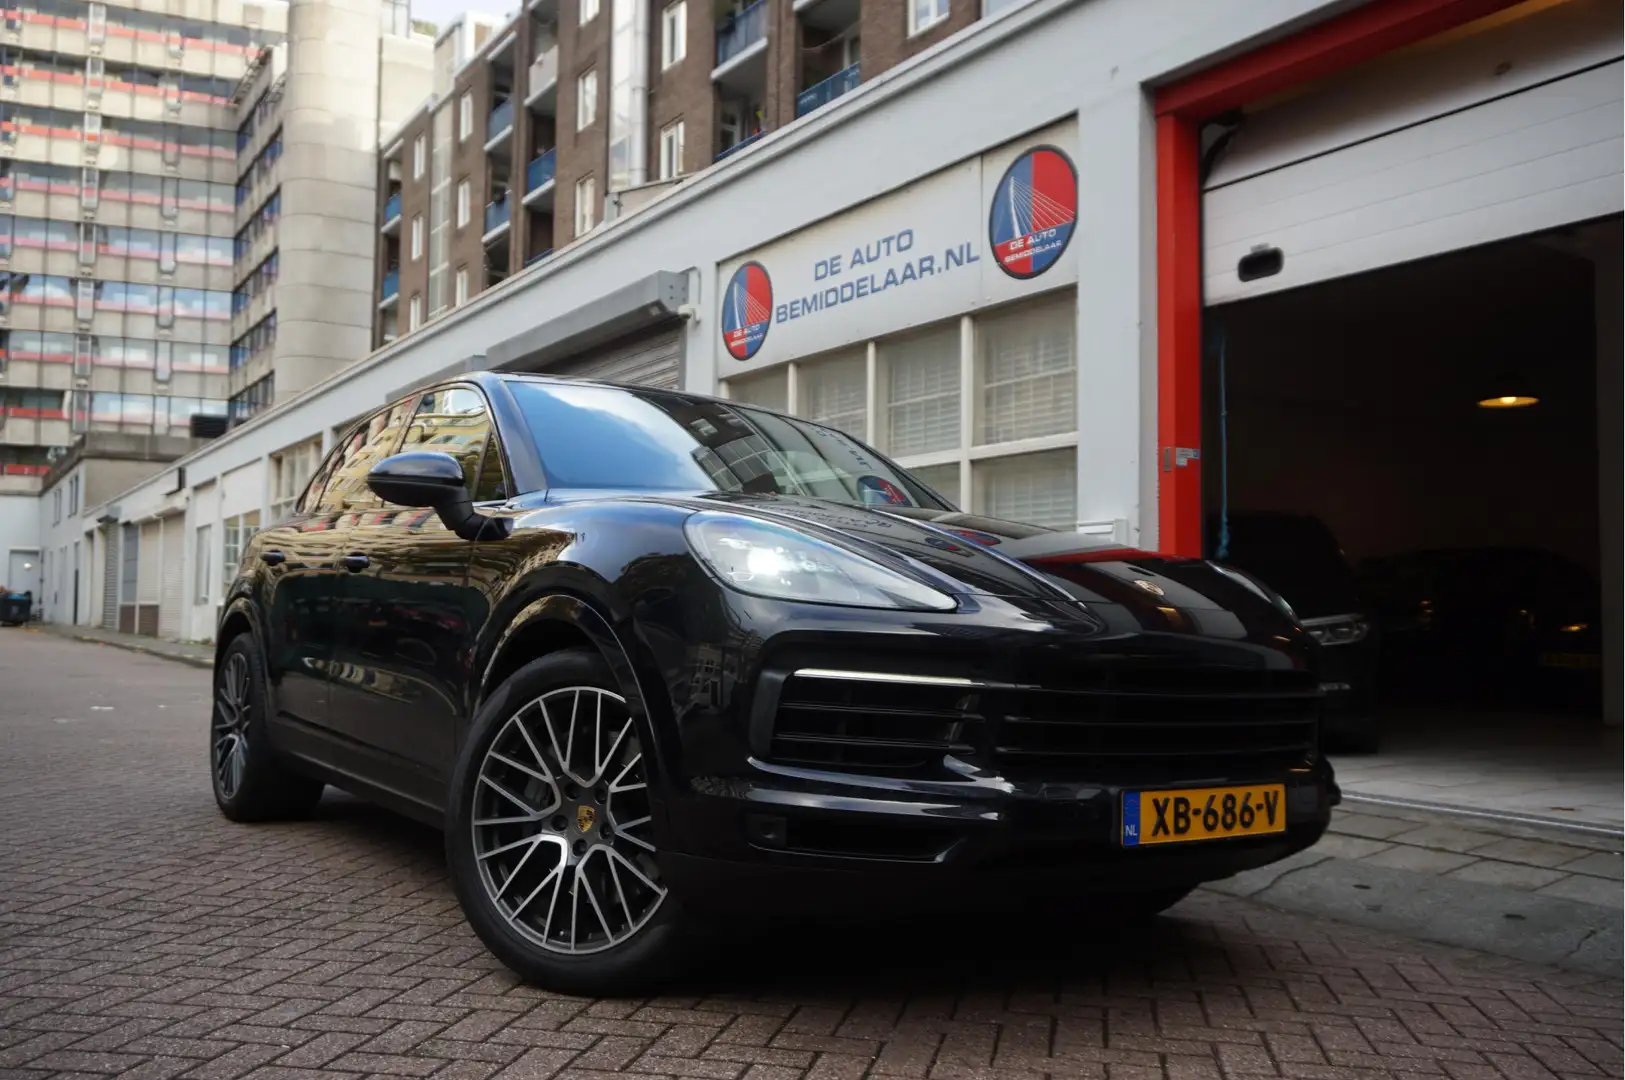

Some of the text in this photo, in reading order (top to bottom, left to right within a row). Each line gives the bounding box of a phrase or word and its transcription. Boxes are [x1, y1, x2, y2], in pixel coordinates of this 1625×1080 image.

[814, 229, 913, 281] DE AUTO
[1009, 229, 1057, 250] DE AUTO
[776, 242, 980, 324] BEMIDDELAAR.NL
[1125, 790, 1280, 837] NL XB-686-V
